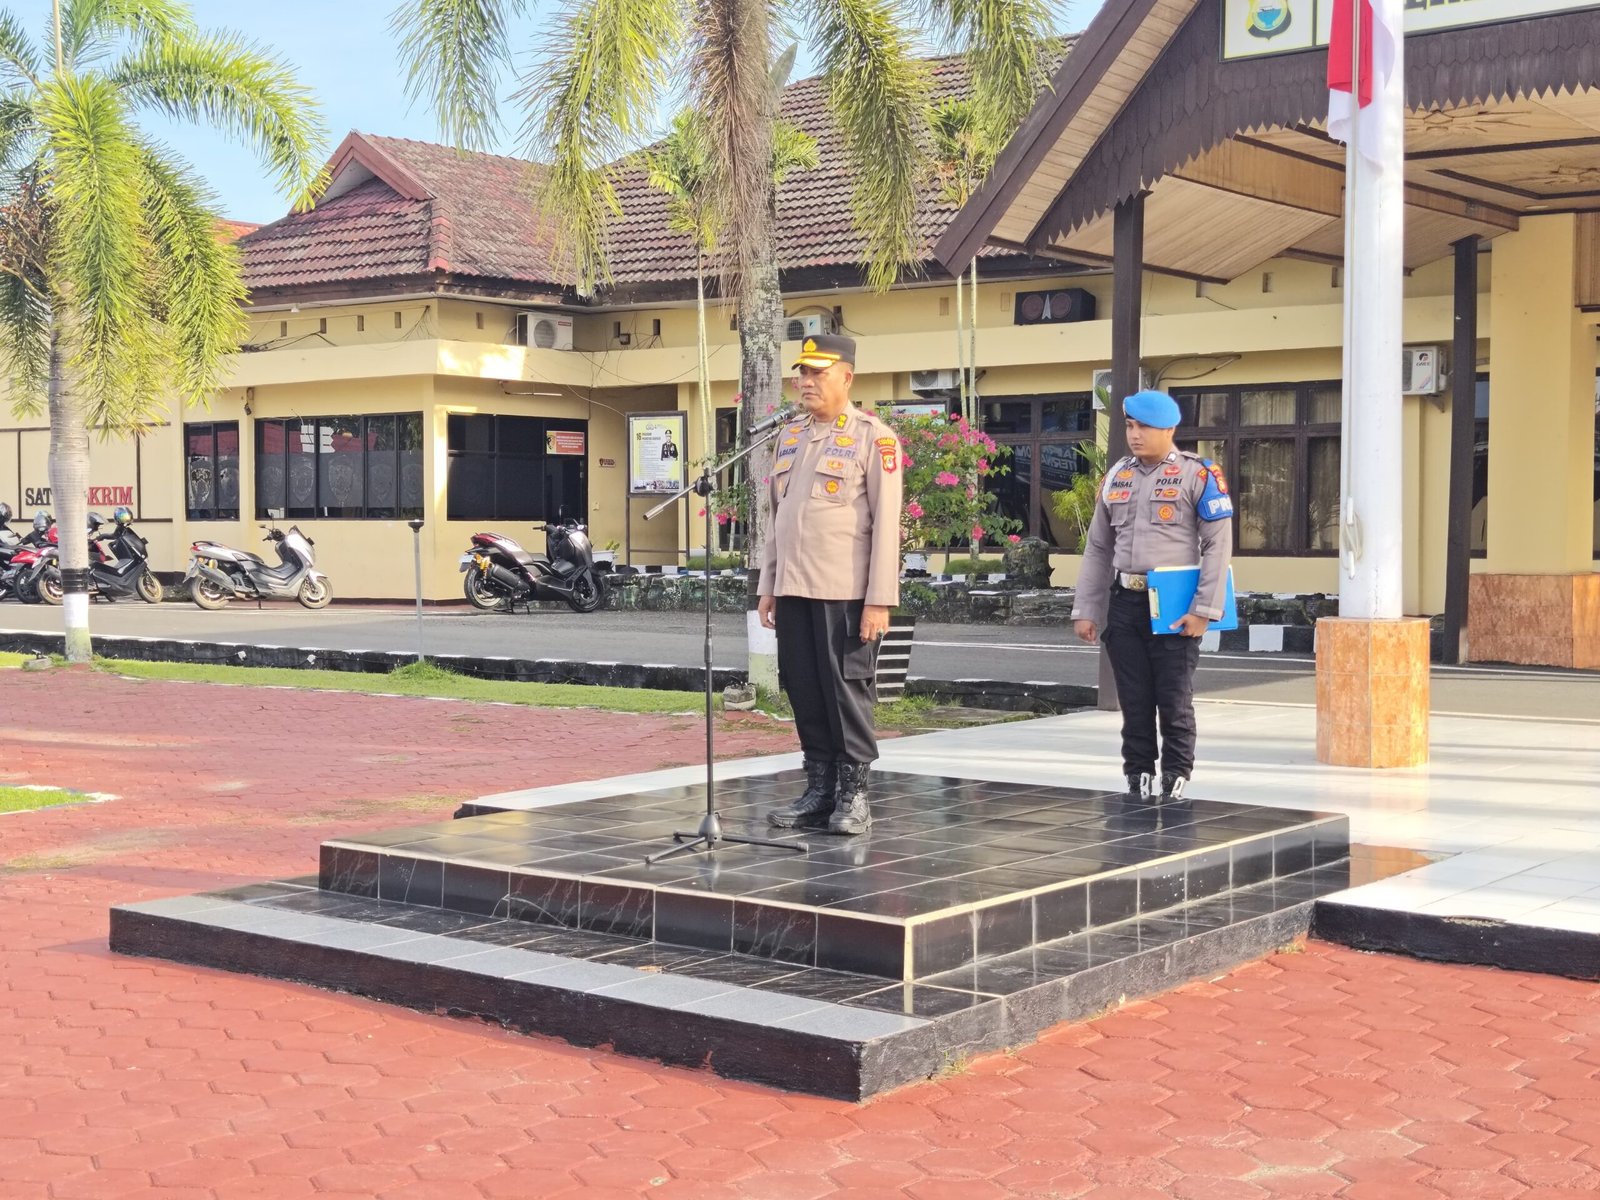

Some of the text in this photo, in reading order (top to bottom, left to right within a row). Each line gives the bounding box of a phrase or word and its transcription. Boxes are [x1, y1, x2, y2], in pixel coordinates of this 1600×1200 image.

[824, 447, 856, 458] POLRI
[1155, 477, 1183, 486] POLRI
[87, 486, 134, 506] KRIM
